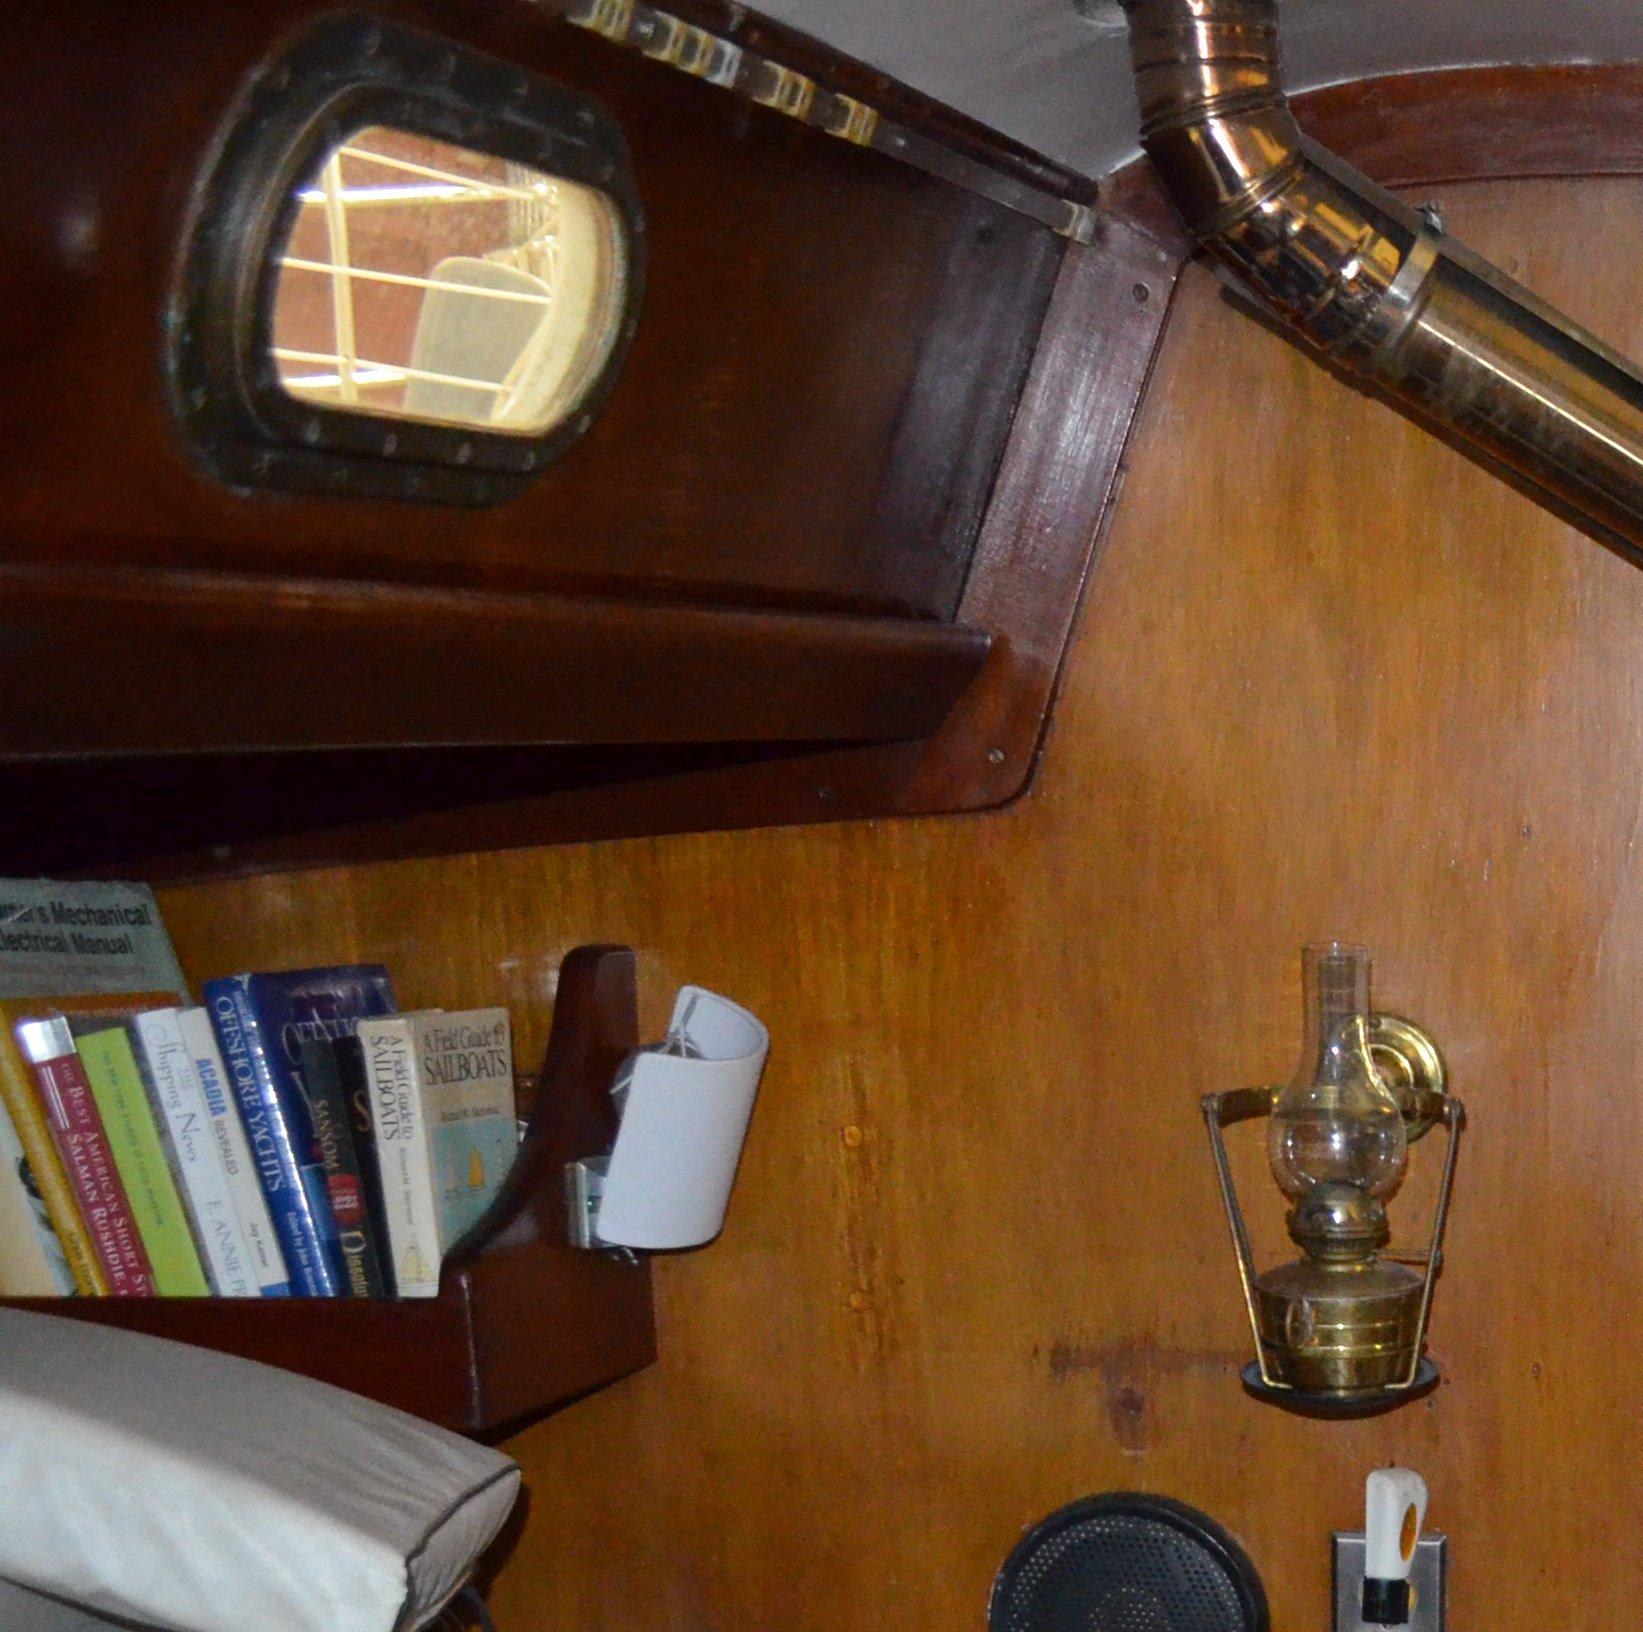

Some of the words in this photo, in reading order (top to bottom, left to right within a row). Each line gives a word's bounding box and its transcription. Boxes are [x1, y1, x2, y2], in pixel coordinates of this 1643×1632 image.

[51, 901, 151, 926] Mechanical
[71, 930, 134, 954] Manual
[393, 1049, 410, 1082] Field
[424, 1049, 507, 1085] SAILBOATS
[433, 1029, 457, 1052] Field
[461, 1026, 491, 1050] Guide
[146, 1023, 182, 1110] Shipping
[177, 1112, 201, 1162] News
[196, 1059, 227, 1116] ACADIA
[213, 1119, 239, 1175] REVEALED
[216, 997, 259, 1110] OFFSHORE
[248, 1111, 286, 1192] YACHTS
[370, 1035, 401, 1142] SAILBOATS
[397, 1082, 415, 1126] Guide
[313, 1100, 341, 1170] SANSOM
[68, 1133, 100, 1203] SALMAN
[69, 1086, 91, 1126] BEST
[84, 1131, 120, 1213] AMERICAN
[113, 1217, 141, 1270] SHORT
[213, 1218, 243, 1277] ANNIE
